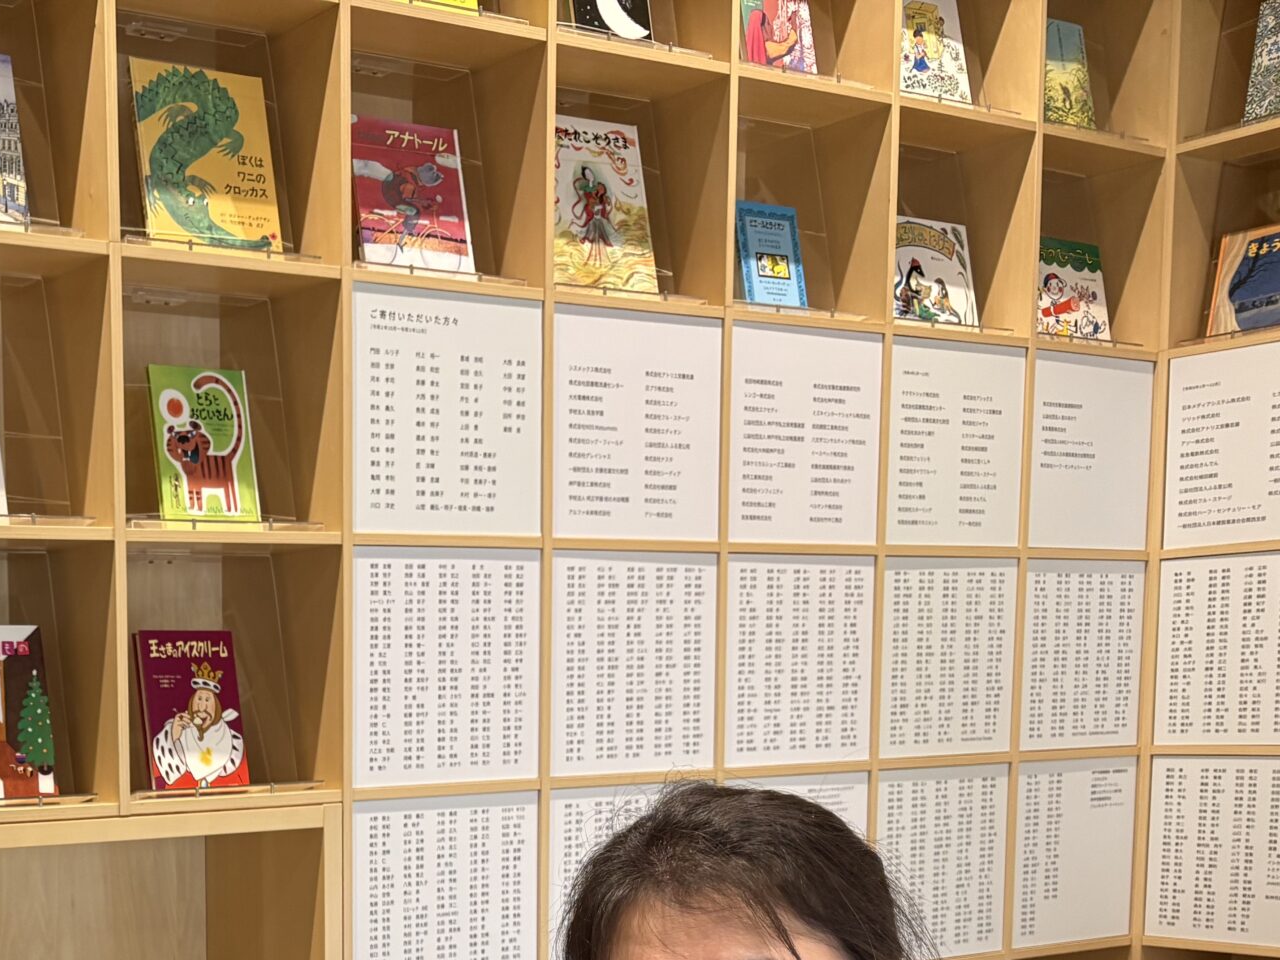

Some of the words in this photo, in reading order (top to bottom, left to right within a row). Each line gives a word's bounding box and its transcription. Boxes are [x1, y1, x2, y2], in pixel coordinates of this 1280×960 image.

[385, 129, 448, 152] アナトール
[237, 155, 265, 168] ぼくは
[237, 171, 267, 184] ワニの
[224, 183, 269, 199] クロッカス
[370, 309, 459, 327] ご寄付いただいた方々
[196, 393, 220, 407] とらと
[190, 407, 233, 421] おじいさん
[148, 639, 228, 659] 王さまのアイスクリーム
